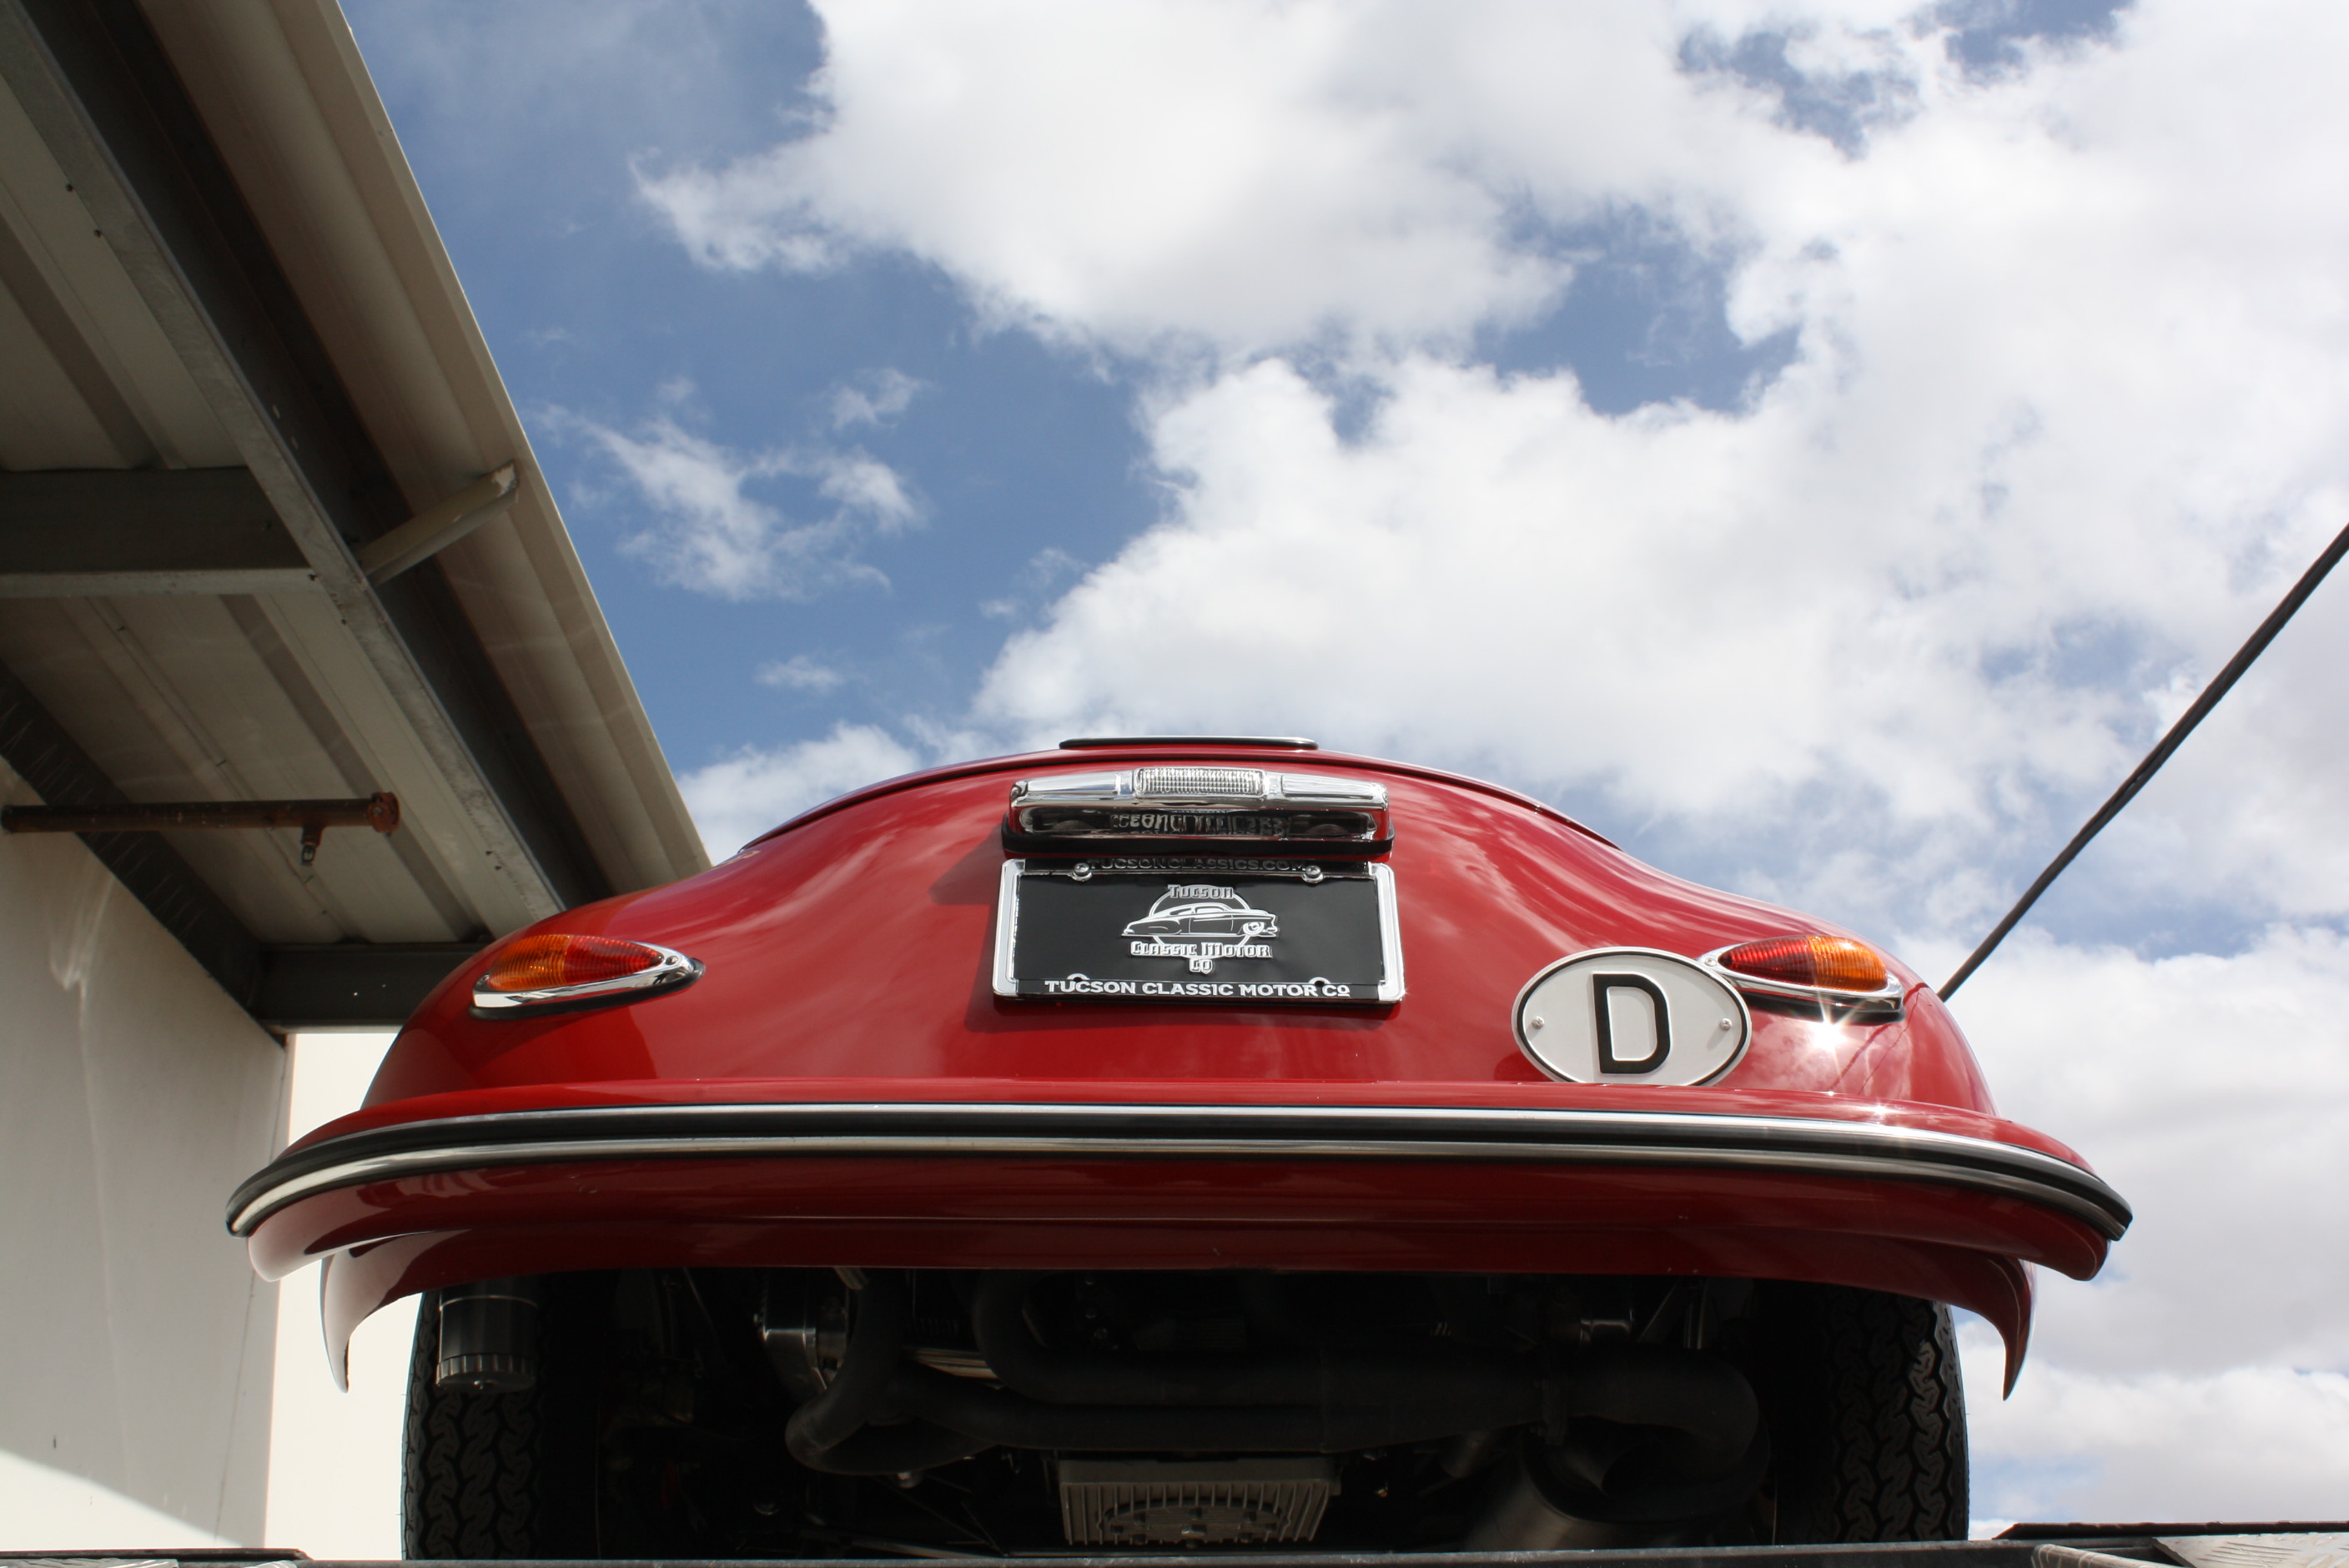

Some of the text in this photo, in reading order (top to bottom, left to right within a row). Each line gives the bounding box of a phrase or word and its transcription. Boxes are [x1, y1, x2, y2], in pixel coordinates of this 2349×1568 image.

[1044, 980, 1136, 995] TUCSON
[1142, 982, 1234, 996] CLASSIC
[1239, 983, 1318, 998] MOTOR
[1593, 972, 1671, 1073] D
